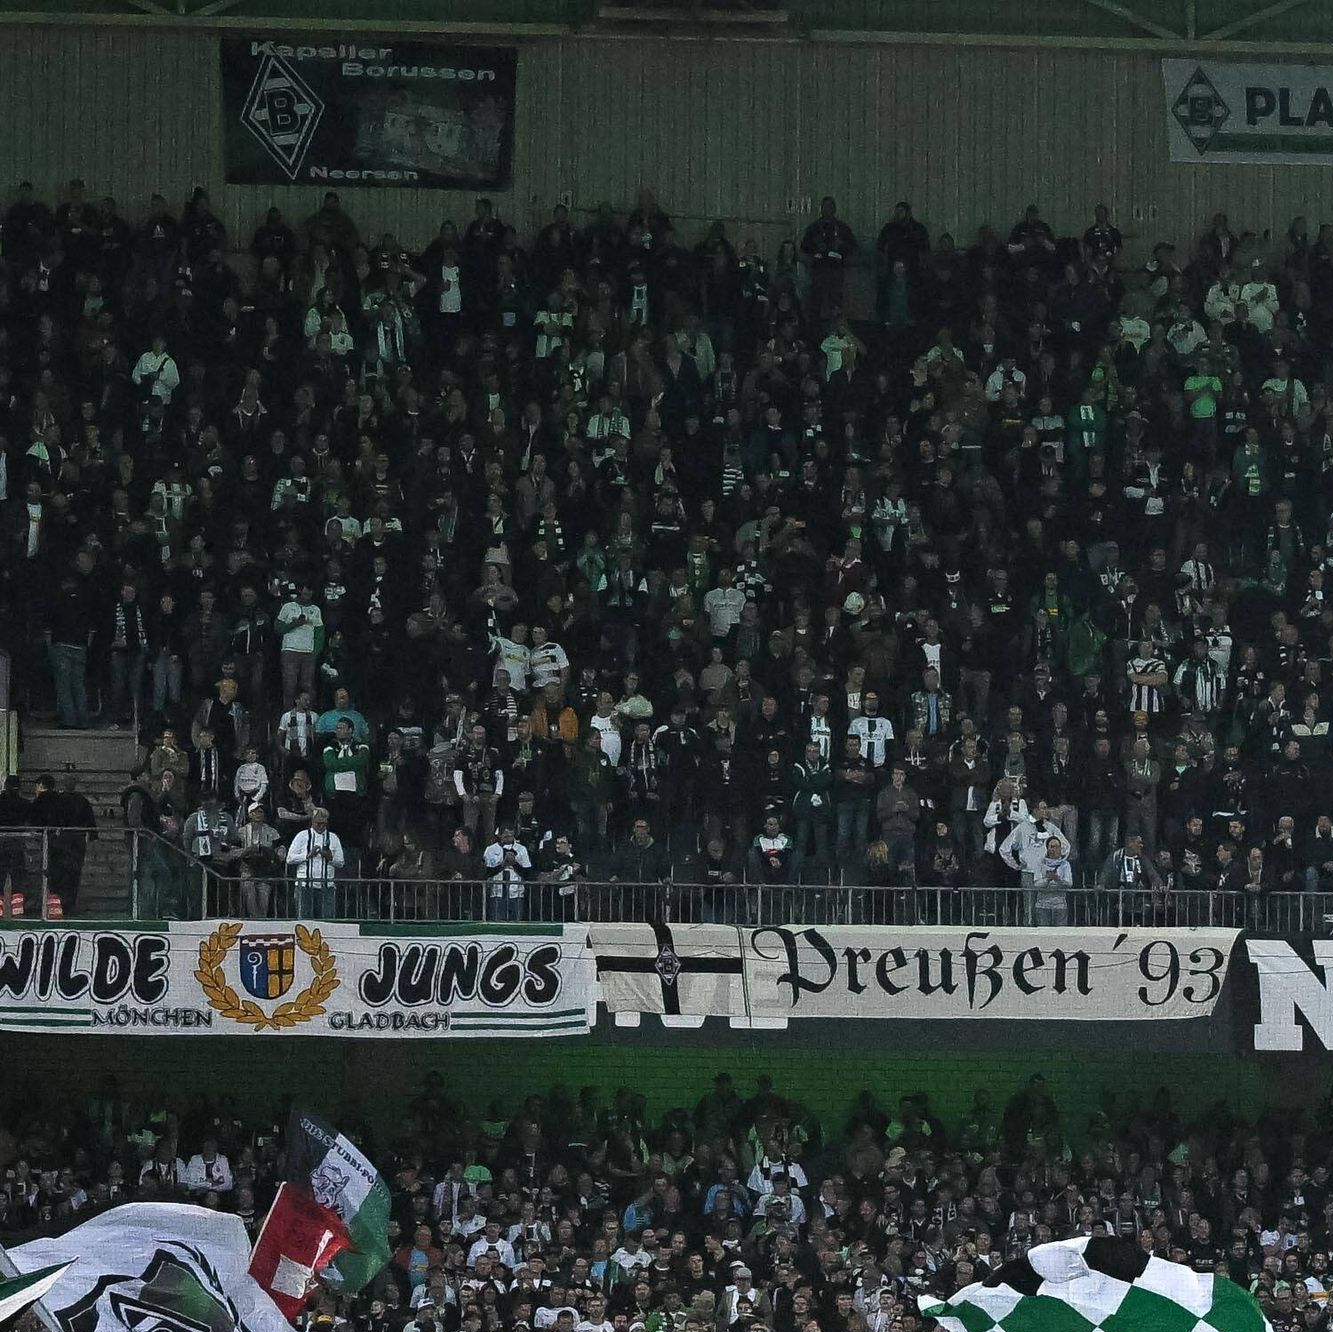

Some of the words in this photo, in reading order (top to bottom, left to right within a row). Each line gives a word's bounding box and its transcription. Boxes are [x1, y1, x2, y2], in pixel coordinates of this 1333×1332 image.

[342, 62, 496, 80] Borussen
[0, 931, 170, 1003] WILDE
[360, 940, 562, 1007] JUNGS
[751, 927, 1094, 1010] Preußen
[92, 1006, 213, 1028] MÖNCHEN
[331, 1011, 451, 1031] GLADBACH
